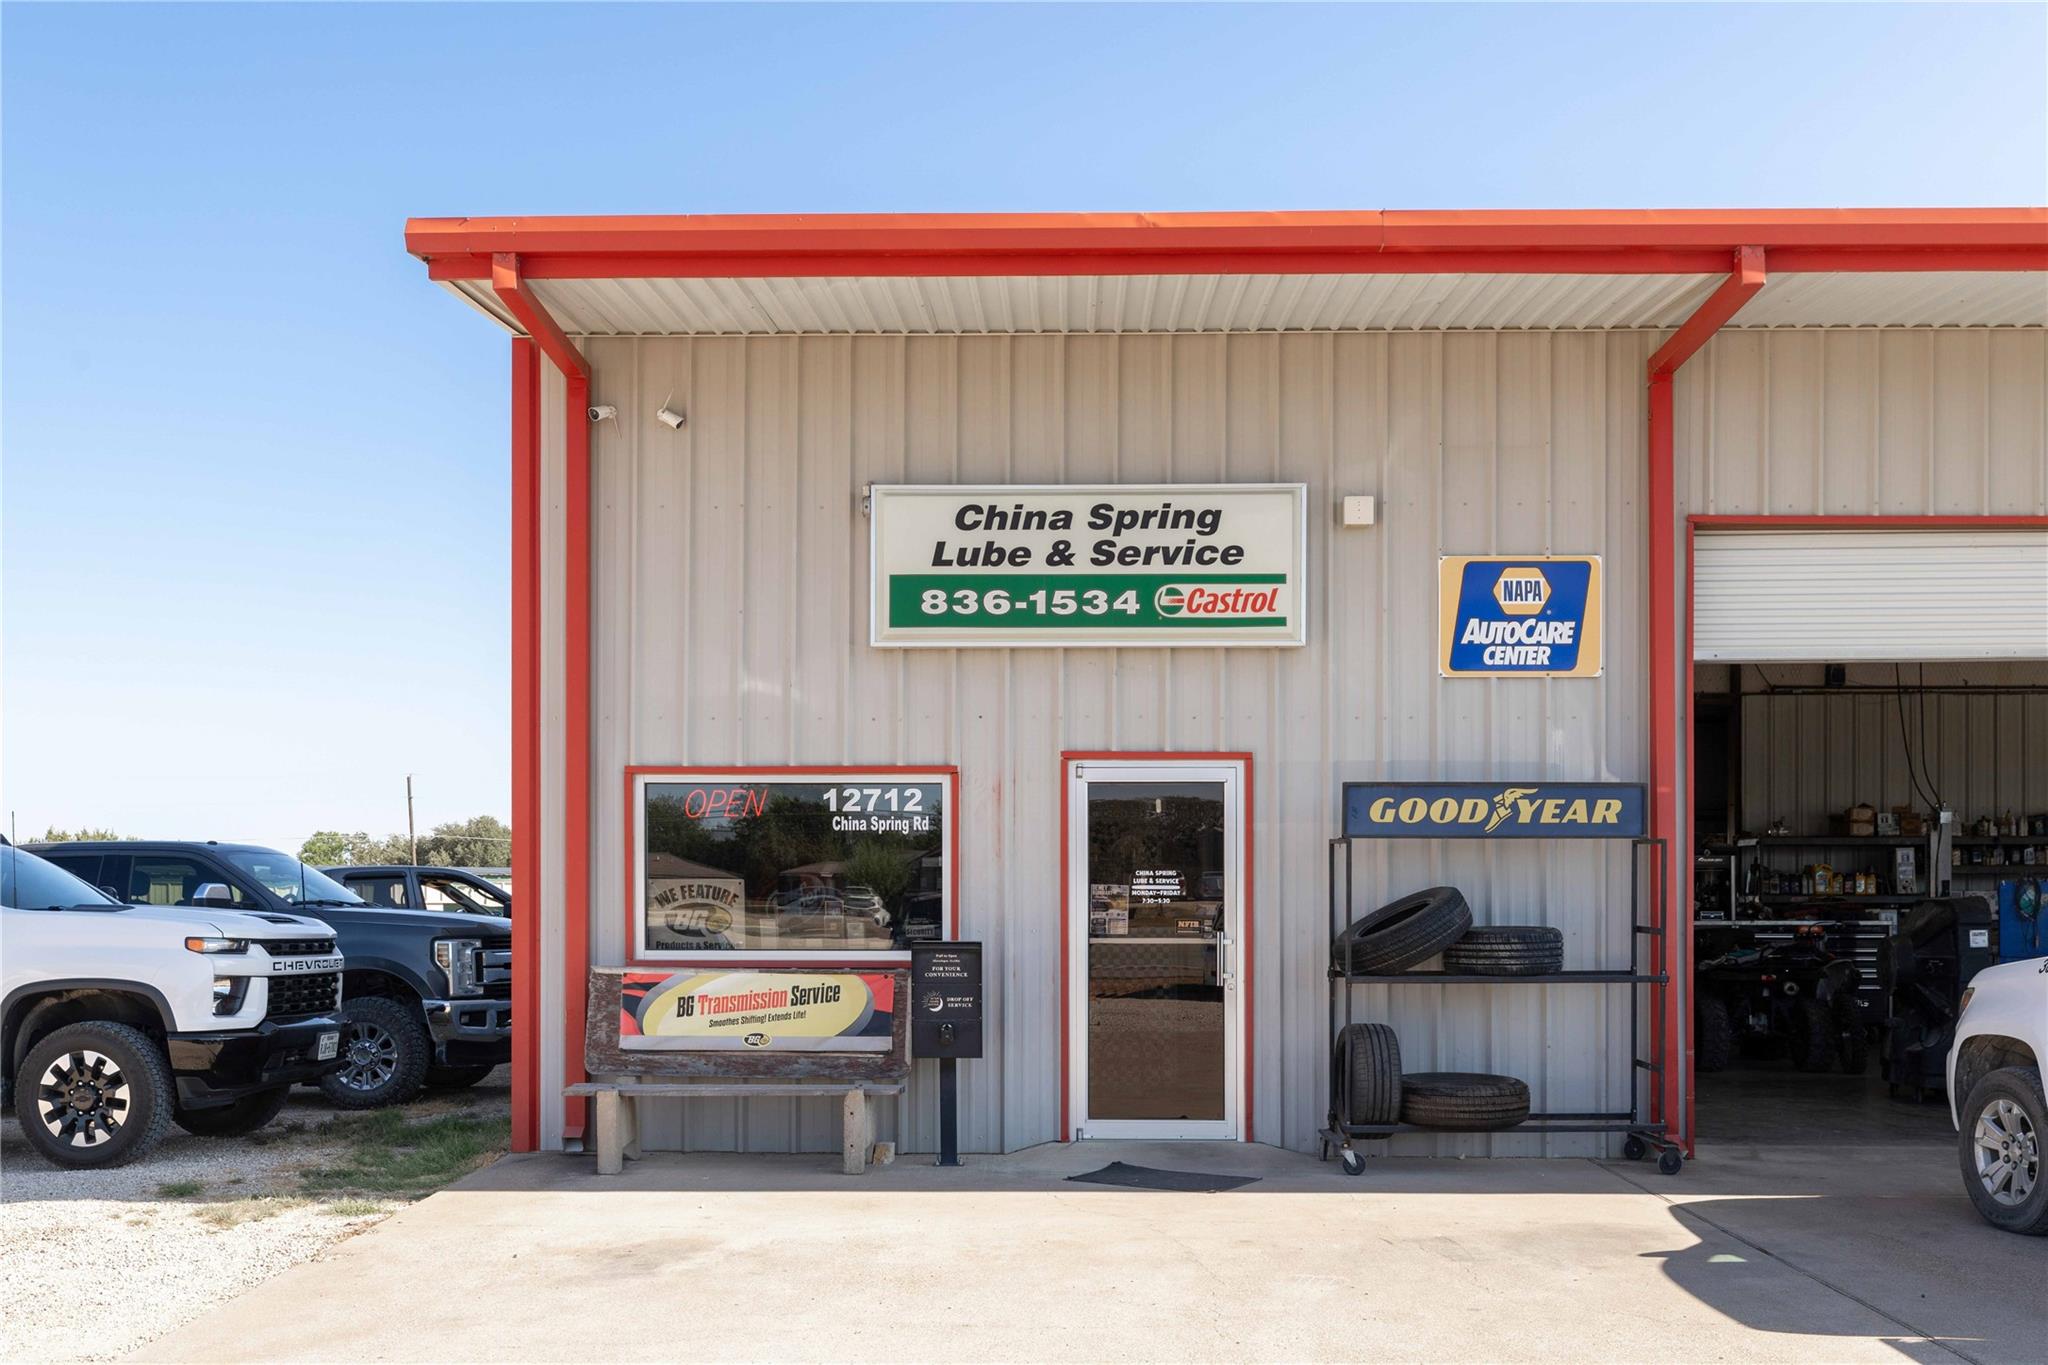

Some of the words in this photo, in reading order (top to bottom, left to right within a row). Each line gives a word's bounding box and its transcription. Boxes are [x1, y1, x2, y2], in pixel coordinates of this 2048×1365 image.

[955, 503, 1073, 531] China
[1087, 502, 1222, 537] Spring
[931, 541, 1032, 567] Lube
[1045, 539, 1076, 567] &
[1089, 539, 1245, 567] Service
[921, 589, 1140, 615] 836-1534
[1186, 587, 1280, 614] Castrol
[1503, 580, 1542, 602] NAPA
[1482, 646, 1551, 665] CENTER
[684, 788, 768, 818] OPEN
[823, 788, 923, 812] 12712
[832, 815, 867, 831] China
[870, 815, 909, 835] Spring
[913, 815, 929, 831] Rd
[655, 888, 679, 908] WE
[680, 884, 739, 908] FEATURE
[656, 941, 694, 950] Products
[676, 996, 695, 1018] BG
[698, 988, 788, 1016] Transmission
[790, 982, 841, 1007] Service
[709, 1017, 740, 1028] Smoothes
[741, 1014, 767, 1025] Shifting!
[768, 1012, 792, 1022] Extends
[793, 1009, 807, 1020] Life!
[747, 1035, 762, 1044] BG
